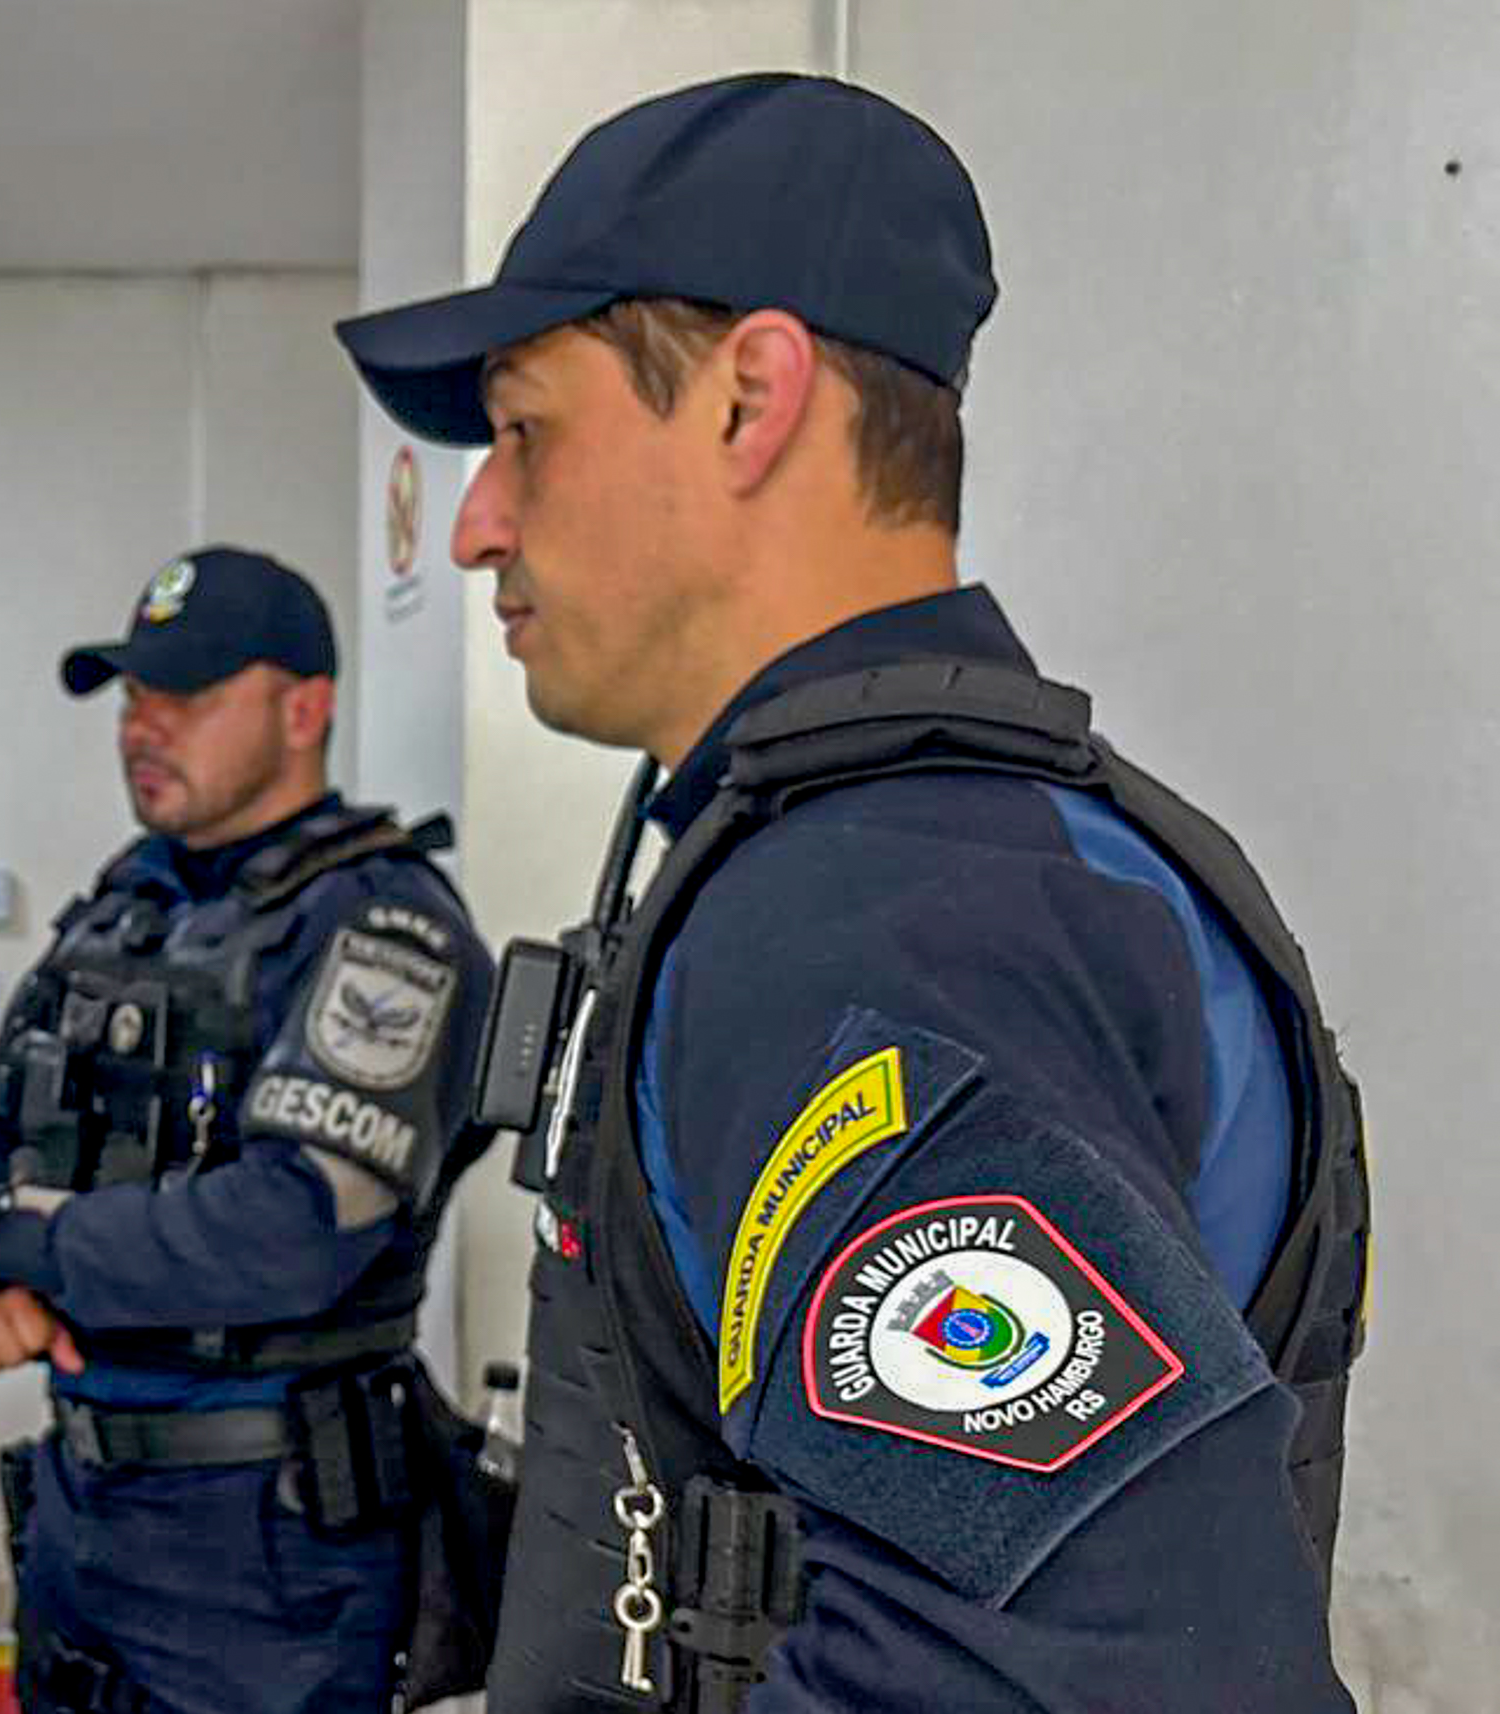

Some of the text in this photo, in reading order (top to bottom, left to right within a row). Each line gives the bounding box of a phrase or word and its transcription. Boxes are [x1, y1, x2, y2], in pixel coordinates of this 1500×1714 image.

[252, 1076, 414, 1172] GESCOM
[727, 1090, 877, 1369] GUARDA MUNICIPAL
[829, 1294, 876, 1403] GUARDA
[855, 1216, 1017, 1293] MUNICIPAL
[963, 1399, 1036, 1434] NOVO
[1036, 1308, 1105, 1414] HAMBURGO
[1065, 1388, 1106, 1422] RS
